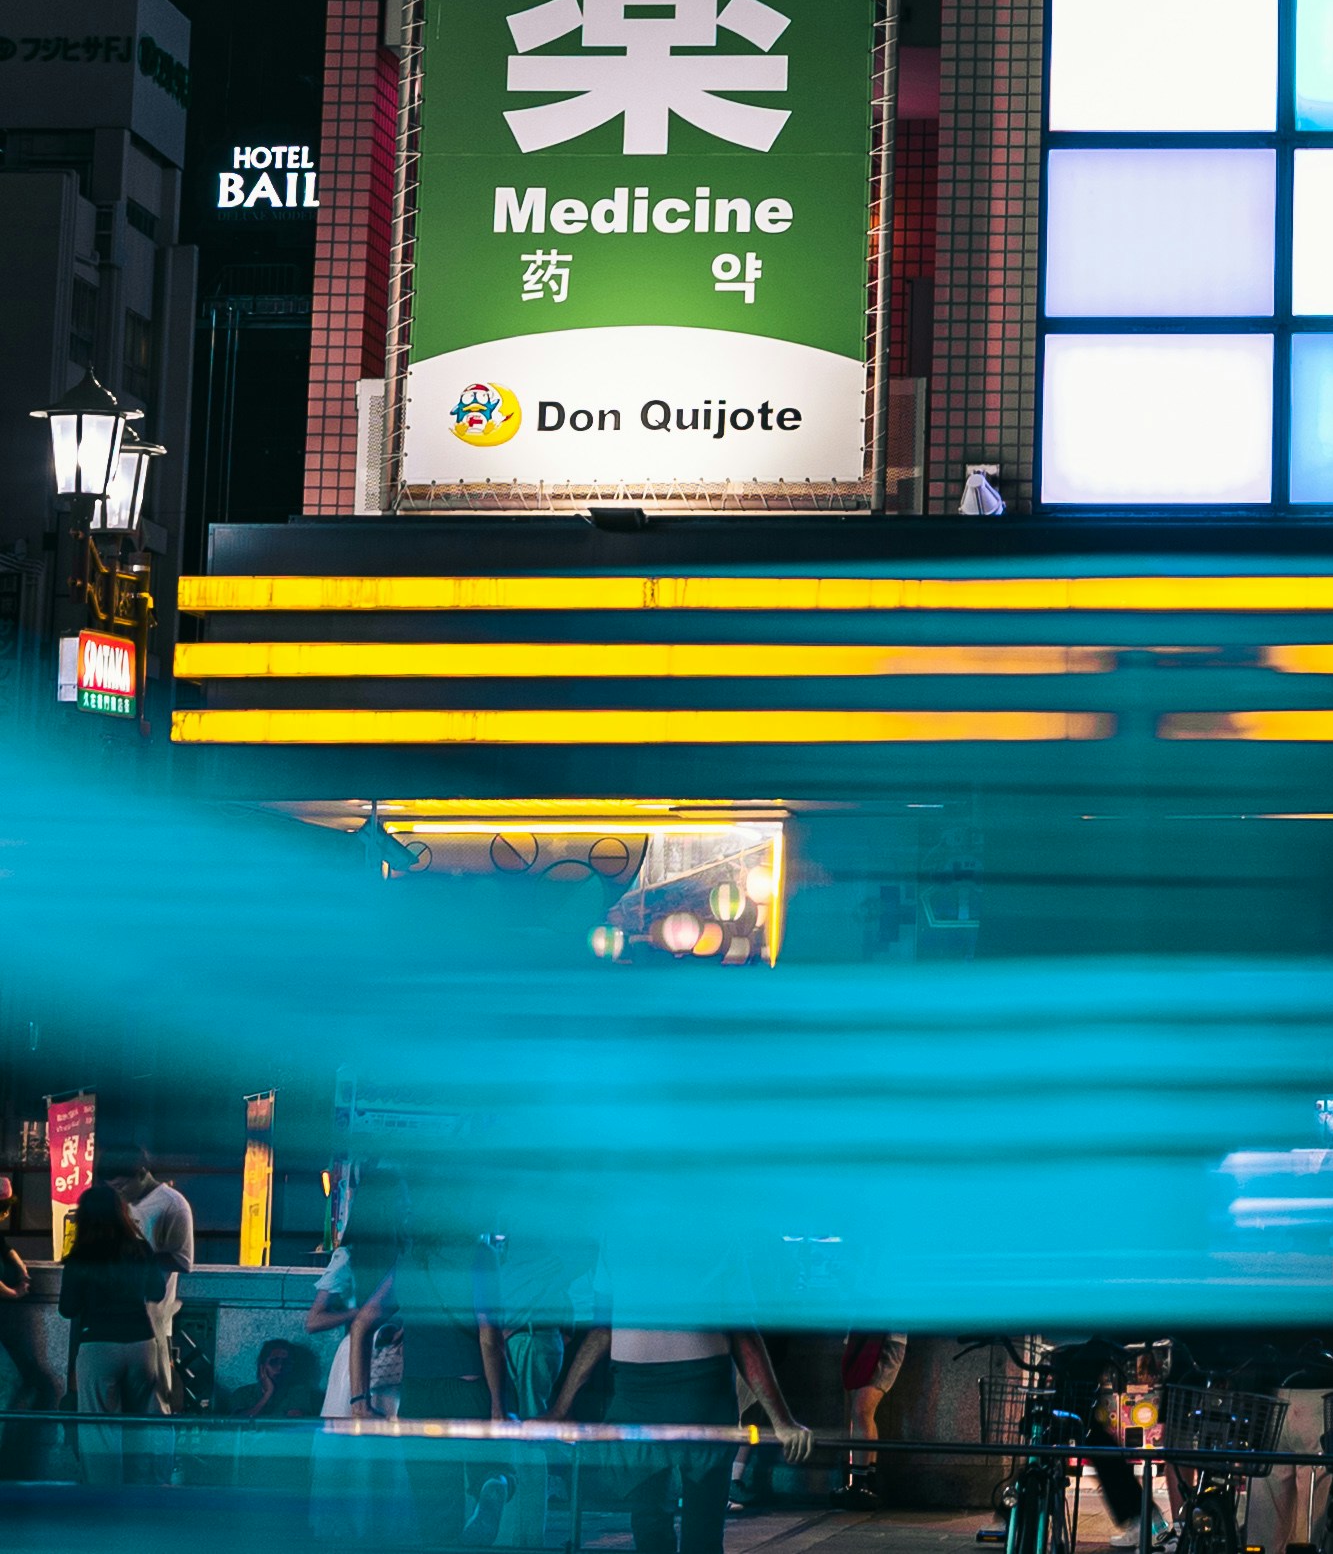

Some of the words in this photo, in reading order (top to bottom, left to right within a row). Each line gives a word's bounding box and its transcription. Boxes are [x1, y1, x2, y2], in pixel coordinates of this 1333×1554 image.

[233, 146, 314, 169] HOTEL
[217, 172, 320, 208] BAIL
[493, 187, 793, 234] Medicine
[521, 250, 573, 303] 药
[712, 251, 763, 304] 약
[537, 400, 621, 433] Don
[640, 398, 803, 440] Quijote
[83, 640, 131, 693] SPOTAKA
